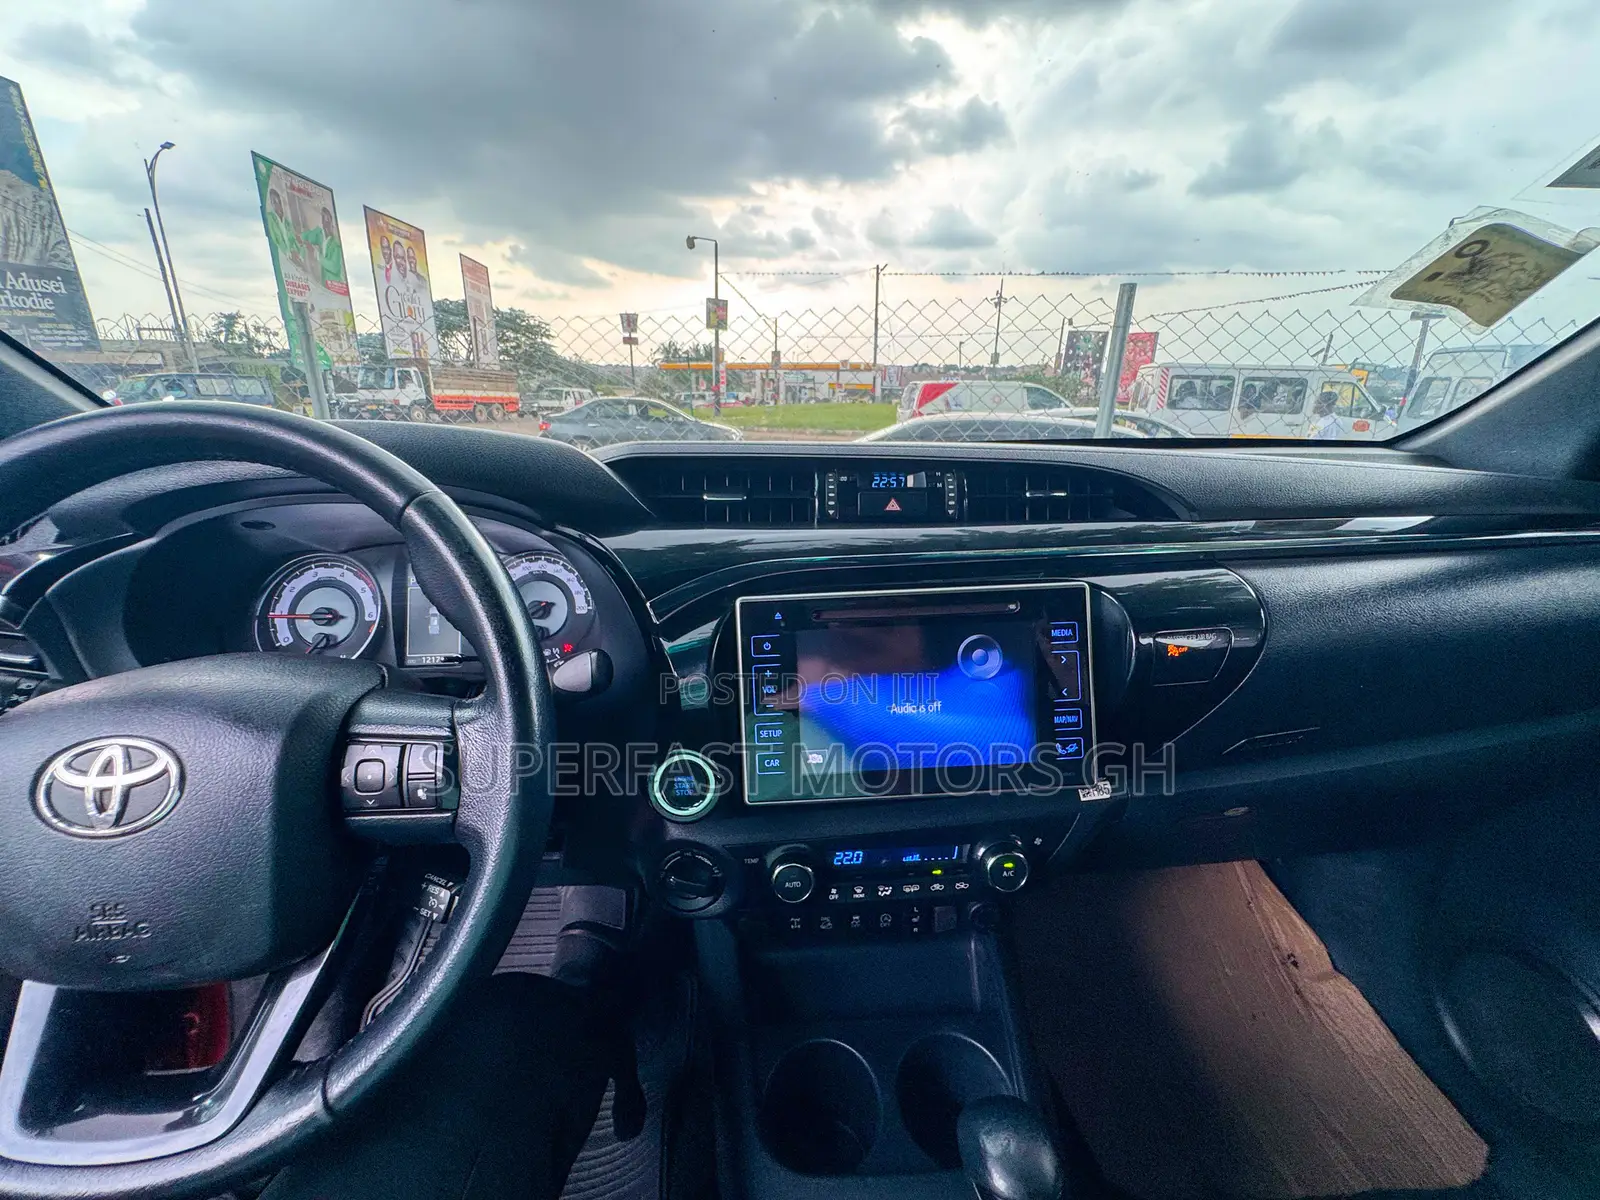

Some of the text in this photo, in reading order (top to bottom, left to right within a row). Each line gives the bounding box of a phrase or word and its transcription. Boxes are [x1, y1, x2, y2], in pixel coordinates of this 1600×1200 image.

[6, 271, 67, 294] Adusei
[1051, 628, 1073, 637] MEDIA
[762, 686, 777, 694] VOL
[890, 700, 942, 713] Audio is off
[1054, 715, 1079, 724] MAP/NAV
[759, 729, 783, 738] SETUP
[764, 759, 780, 767] CAR
[833, 850, 864, 866] 22.0
[1002, 869, 1015, 878] A/C
[424, 873, 447, 886] CANCEL
